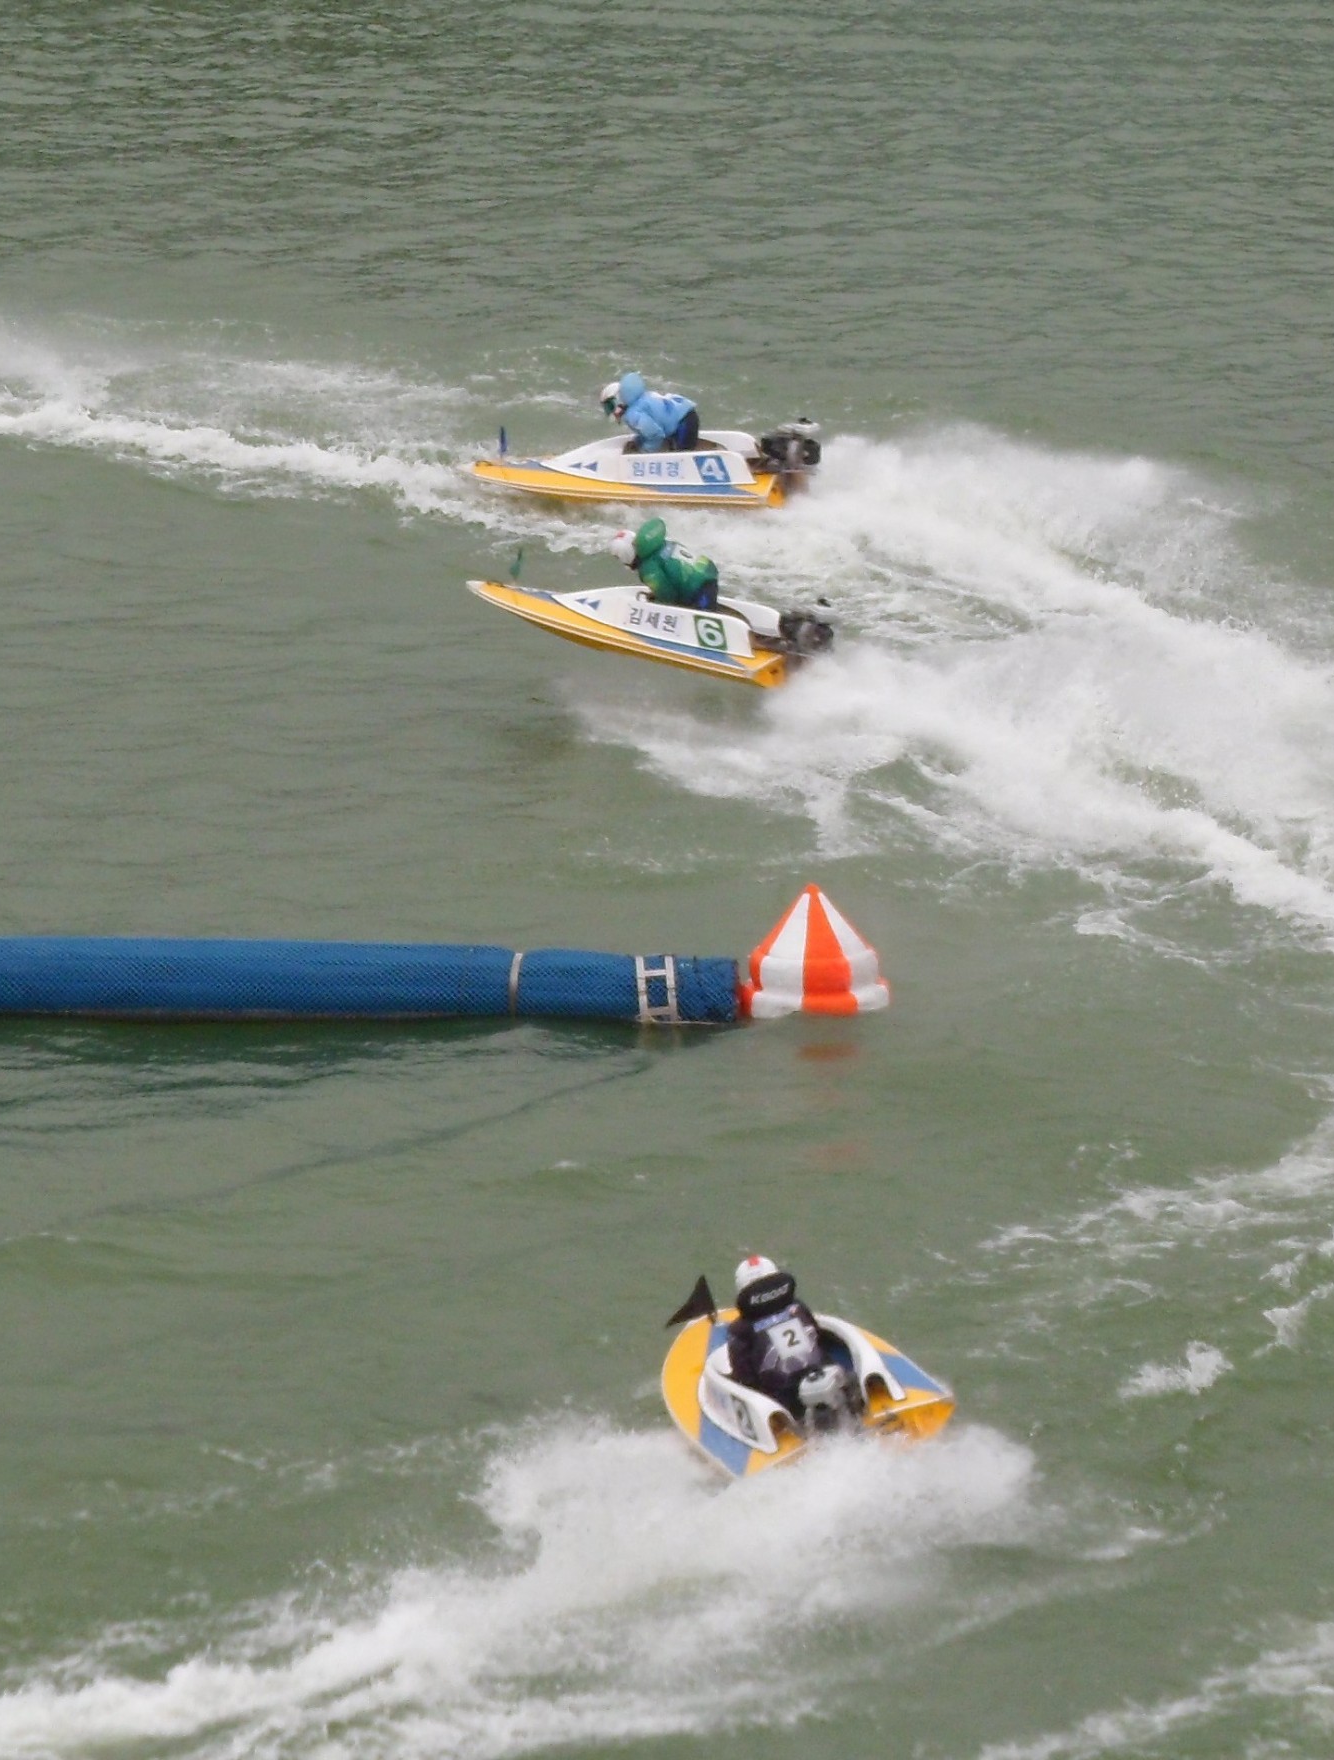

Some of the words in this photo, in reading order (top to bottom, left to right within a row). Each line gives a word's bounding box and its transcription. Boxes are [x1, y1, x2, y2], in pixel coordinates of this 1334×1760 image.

[700, 457, 726, 480] 4
[629, 607, 678, 633] 김세원
[697, 618, 725, 647] 6
[782, 1329, 800, 1347] 2
